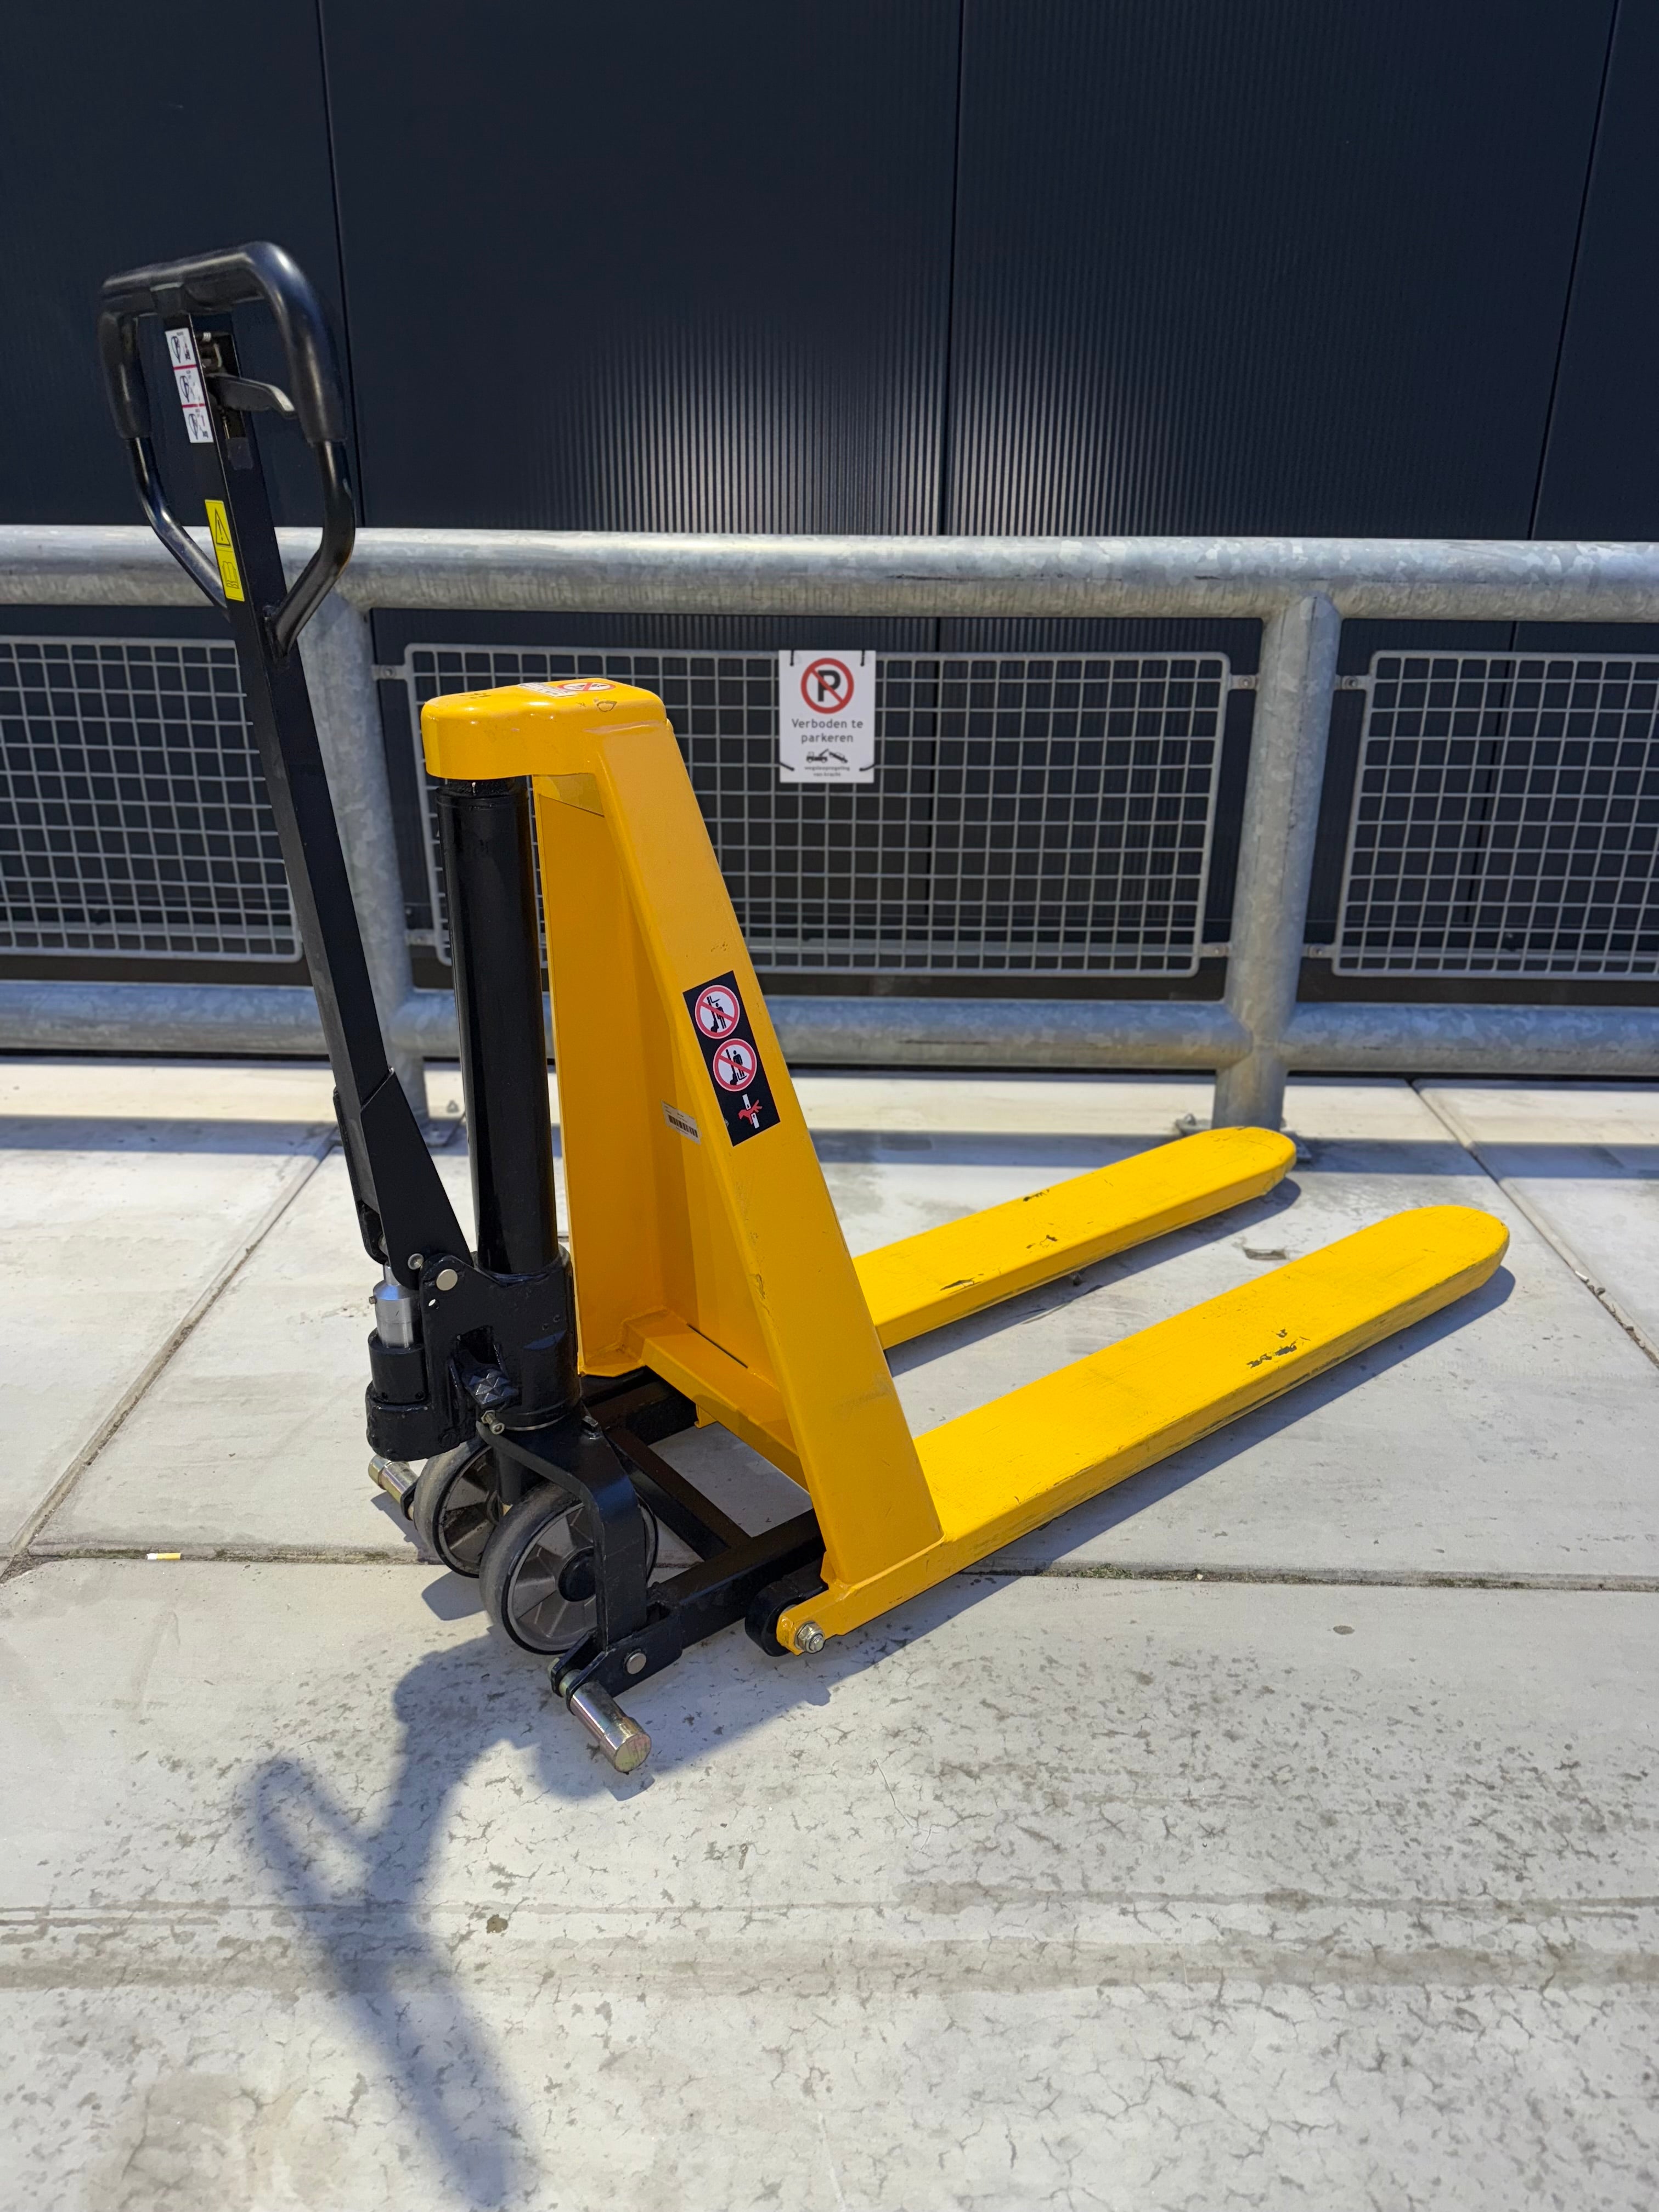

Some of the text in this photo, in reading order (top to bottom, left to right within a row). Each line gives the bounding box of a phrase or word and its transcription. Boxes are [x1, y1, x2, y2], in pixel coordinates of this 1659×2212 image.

[817, 670, 840, 702] P
[791, 718, 864, 729] Verboden te
[801, 732, 854, 744] parkeren
